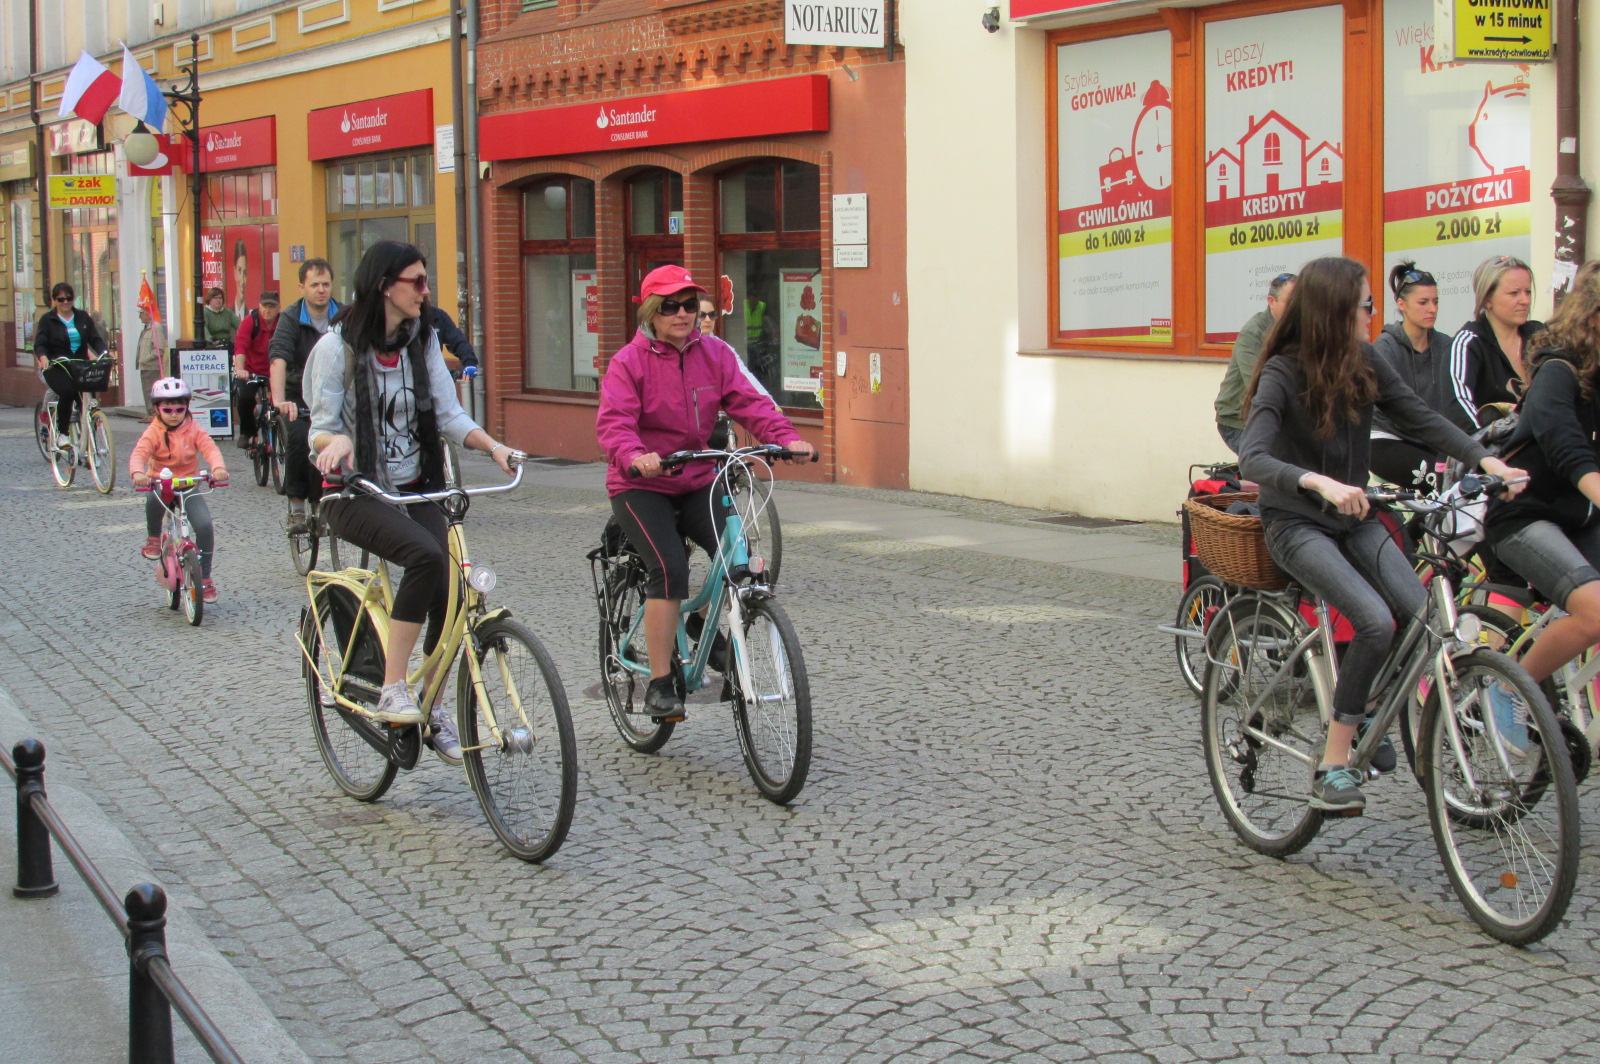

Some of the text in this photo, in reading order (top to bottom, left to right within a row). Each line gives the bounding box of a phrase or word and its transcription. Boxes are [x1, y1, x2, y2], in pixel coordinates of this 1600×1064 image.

[792, 4, 879, 34] NOTARIUSZ
[1475, 12, 1542, 28] w 15 minut
[1217, 42, 1265, 68] Lepszy
[1064, 70, 1099, 93] Szybka
[1226, 60, 1293, 92] KREDYT!
[1071, 82, 1136, 111] GOTÓWKA!
[351, 108, 388, 130] Santander
[610, 104, 656, 127] Santander
[214, 131, 242, 149] Santander
[611, 131, 648, 142] CONSUMER BANK
[78, 177, 101, 188] żak
[70, 195, 114, 206] DARMO!
[1243, 191, 1306, 217] KREDYTY
[1426, 179, 1513, 211] POŻYCZKI
[1078, 199, 1153, 228] CHWILÓWKI
[1085, 225, 1146, 250] do 1.000 zł
[1229, 216, 1320, 246] do 200.000 zł
[1436, 211, 1502, 241] 2.000 zł
[183, 363, 226, 371] MATERACE
[191, 353, 217, 362] ŁÓŻKA
